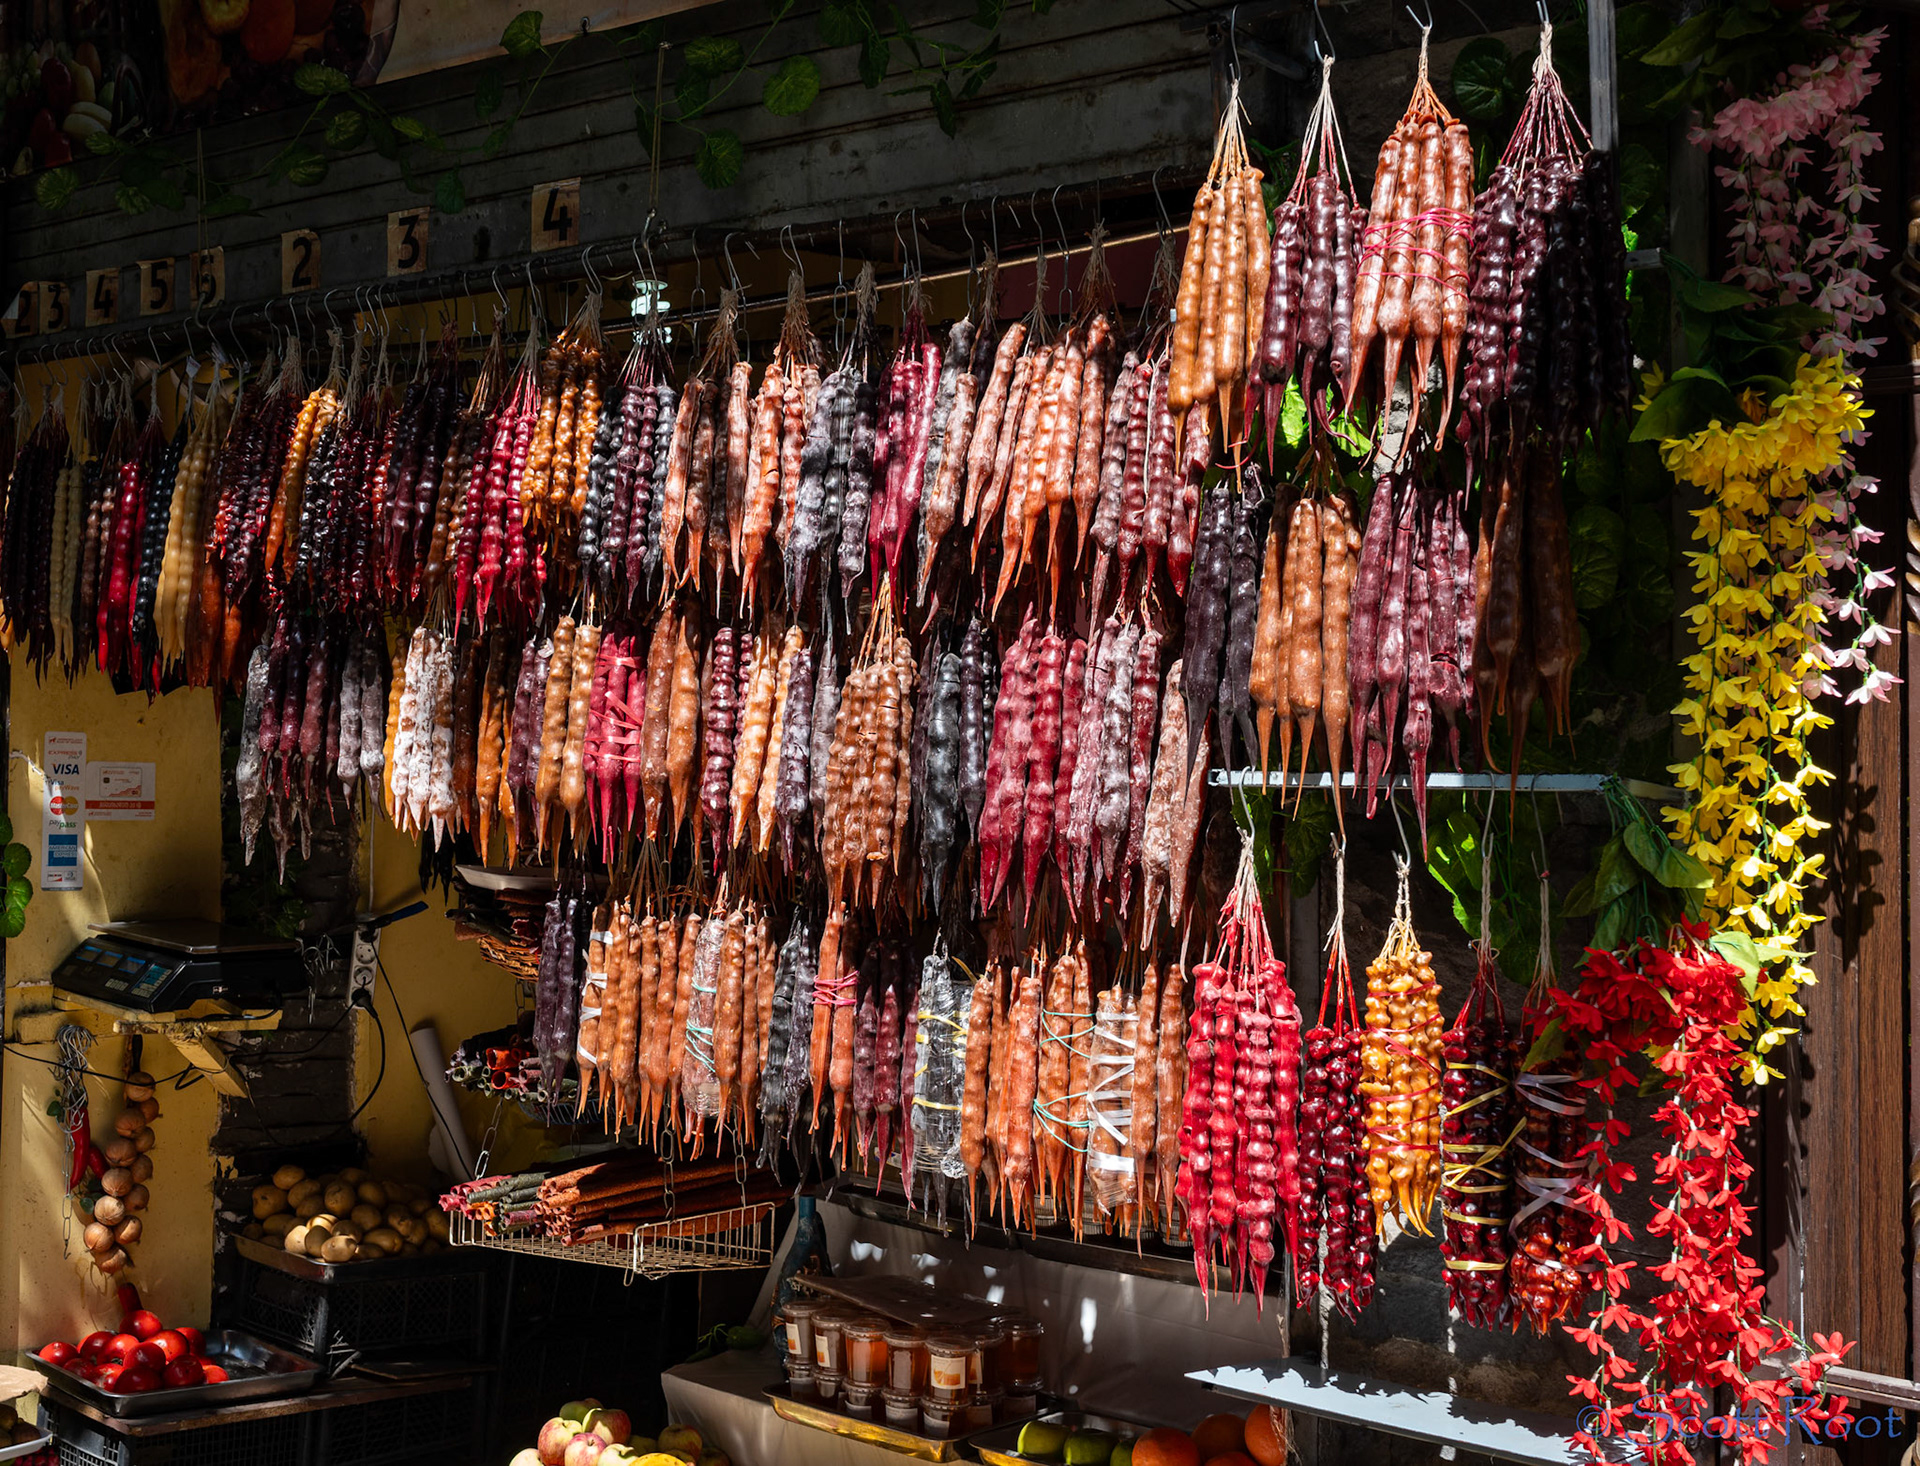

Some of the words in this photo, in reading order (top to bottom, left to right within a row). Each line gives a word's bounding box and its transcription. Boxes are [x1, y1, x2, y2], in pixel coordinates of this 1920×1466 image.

[542, 187, 572, 242] 4
[292, 236, 312, 288] 2
[398, 214, 420, 269] 3
[48, 284, 64, 329] 3
[93, 274, 114, 318] 4
[150, 261, 168, 309] 5
[15, 290, 31, 334] 2
[52, 763, 80, 775] VISA
